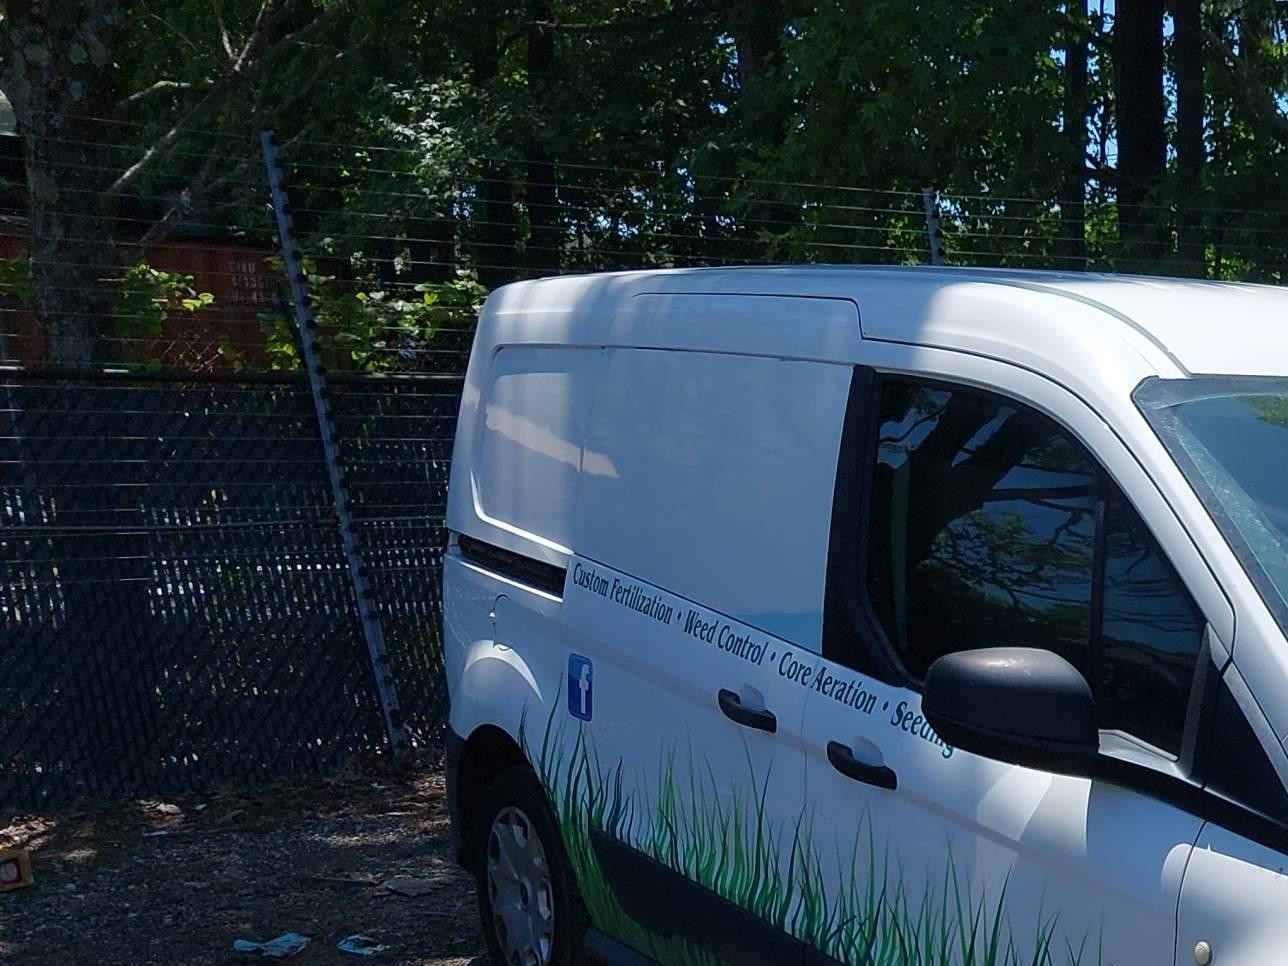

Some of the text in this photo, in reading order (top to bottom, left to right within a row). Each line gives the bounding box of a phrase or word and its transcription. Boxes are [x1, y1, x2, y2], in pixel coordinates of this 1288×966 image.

[572, 562, 608, 597] Custom
[609, 578, 674, 625] Fertilization
[683, 609, 718, 644] Weed
[717, 625, 769, 666] Control
[778, 651, 812, 686] Core
[811, 666, 877, 714] Aeration
